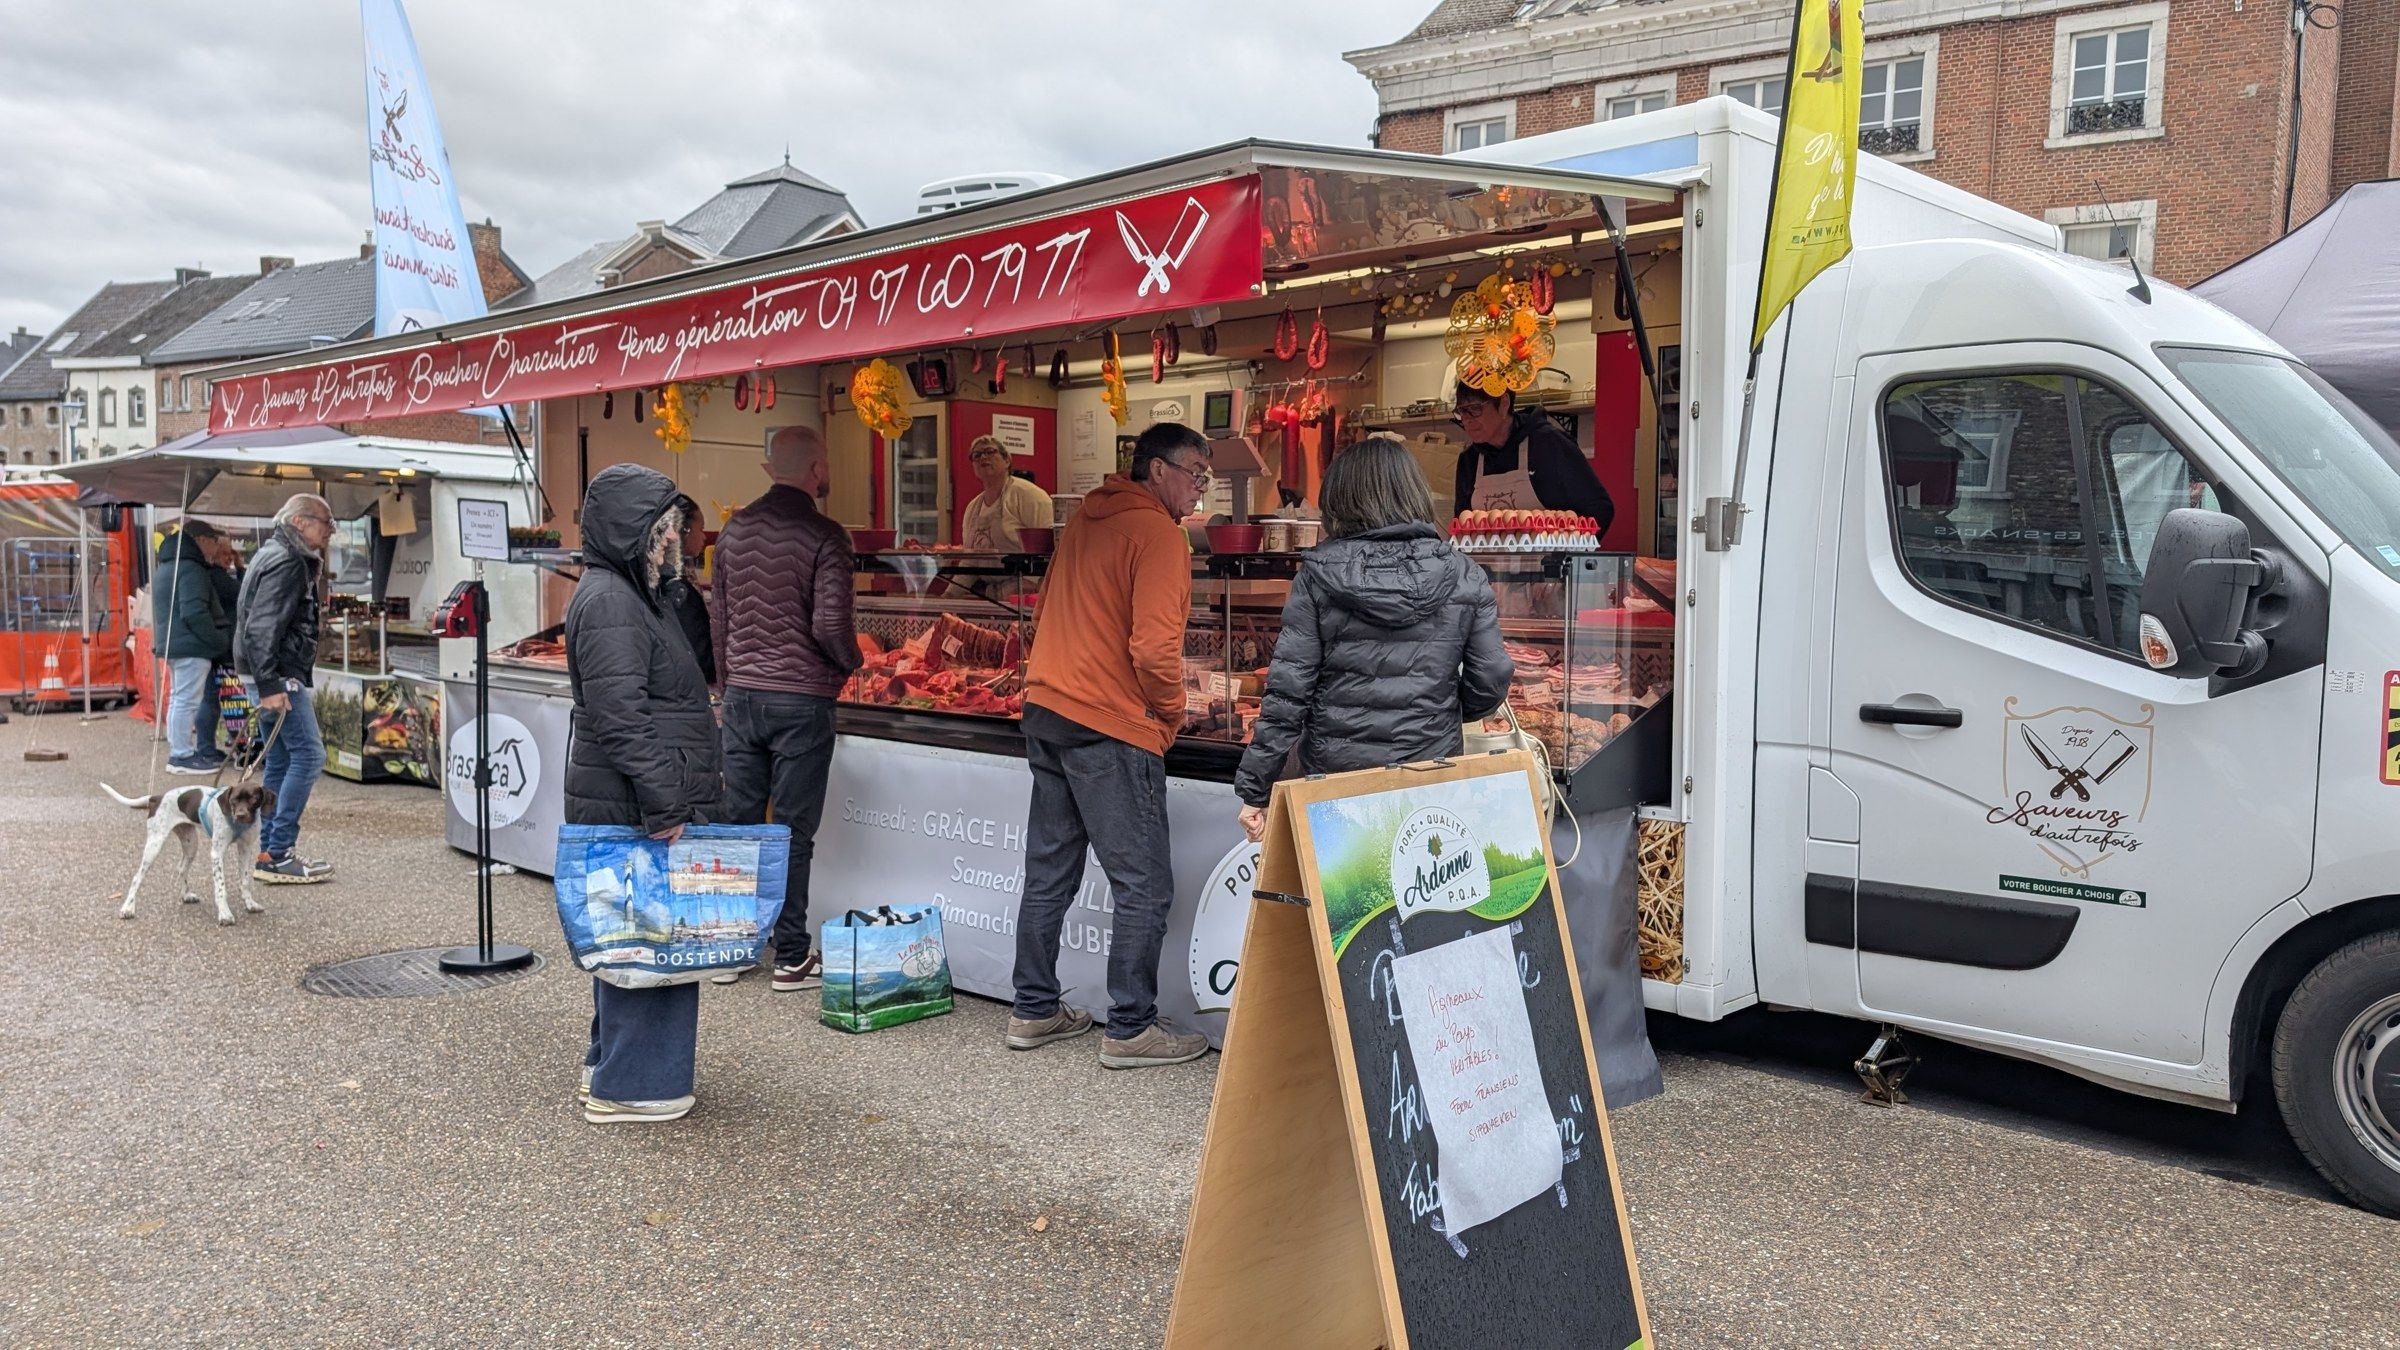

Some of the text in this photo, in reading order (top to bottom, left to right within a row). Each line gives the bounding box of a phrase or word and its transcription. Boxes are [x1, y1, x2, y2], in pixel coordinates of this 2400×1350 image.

[250, 228, 1091, 427] Saveurs d'Autrefois Boucher Charcutier 4ème génération 04 97 60 79 77
[2061, 725, 2094, 736] Depuis
[2064, 737, 2090, 748] 1918
[842, 797, 907, 832] Samedi
[923, 808, 997, 847] GRÂCE
[1987, 791, 2129, 828] Saveurs
[1399, 814, 1467, 855] PORC QUALITÉ
[2030, 825, 2143, 852] d'autrefois
[950, 855, 1026, 896] Samedi
[1404, 850, 1472, 908] Ardenne
[2003, 879, 2031, 890] VOTRE
[2033, 883, 2074, 895] BOUCHER
[2076, 889, 2083, 897] A
[2084, 889, 2115, 900] CHOISI
[1448, 886, 1481, 903] P.Q.A.
[931, 892, 1015, 937] Dimanch
[656, 948, 756, 966] OOSTENDE
[1428, 984, 1484, 1030] Agneaux
[1450, 1022, 1475, 1055] Pays
